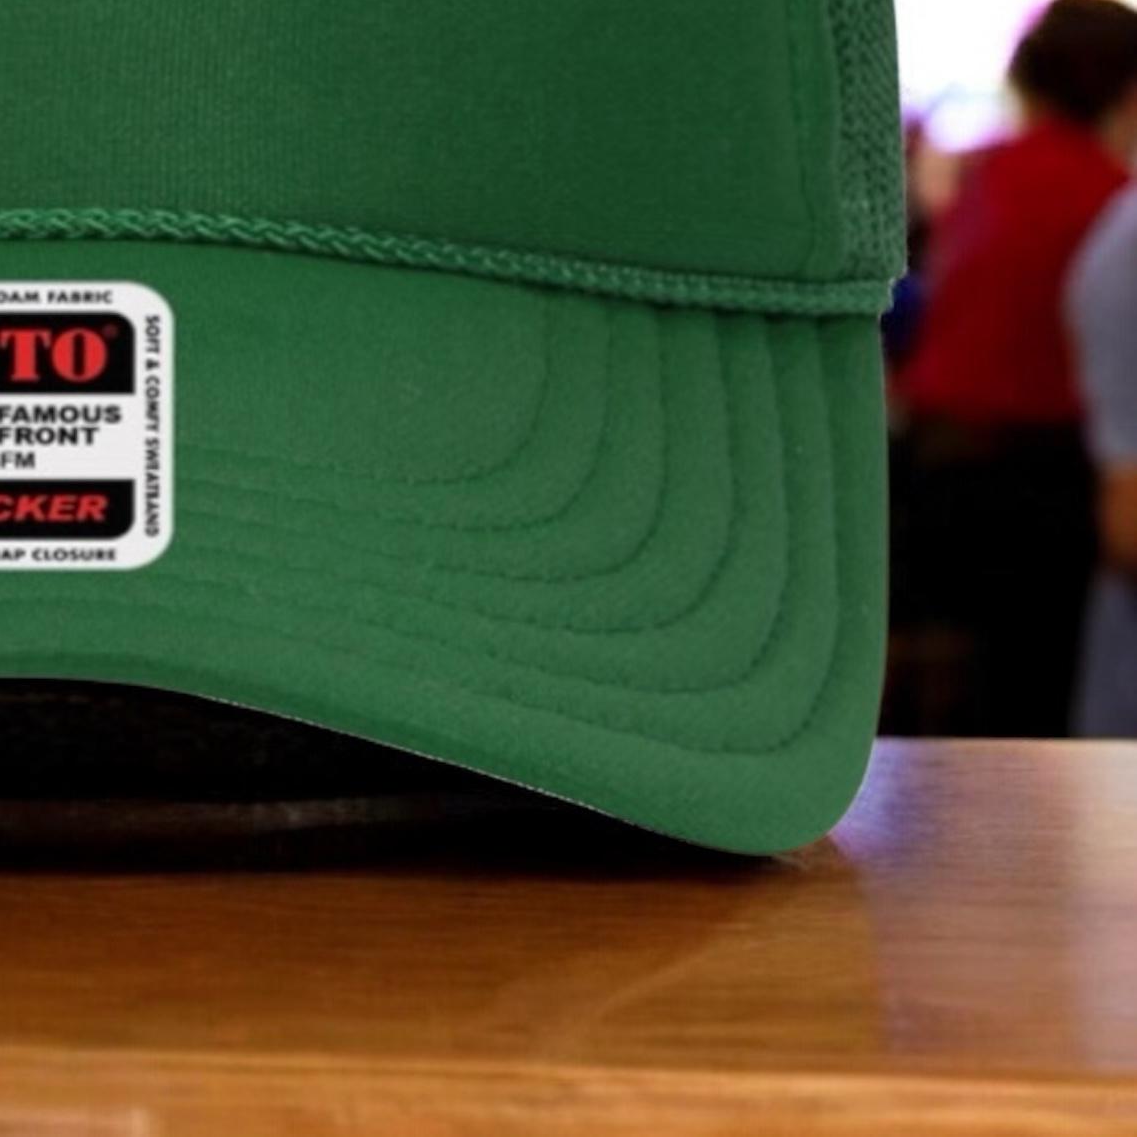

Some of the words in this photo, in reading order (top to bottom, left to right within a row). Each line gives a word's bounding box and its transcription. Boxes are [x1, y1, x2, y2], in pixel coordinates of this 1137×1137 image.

[48, 291, 113, 303] FABRIC
[146, 315, 160, 353] SOFT
[146, 376, 160, 431] COMFY
[145, 437, 159, 537] SWEATBAND
[32, 548, 115, 561] CLOSURE
